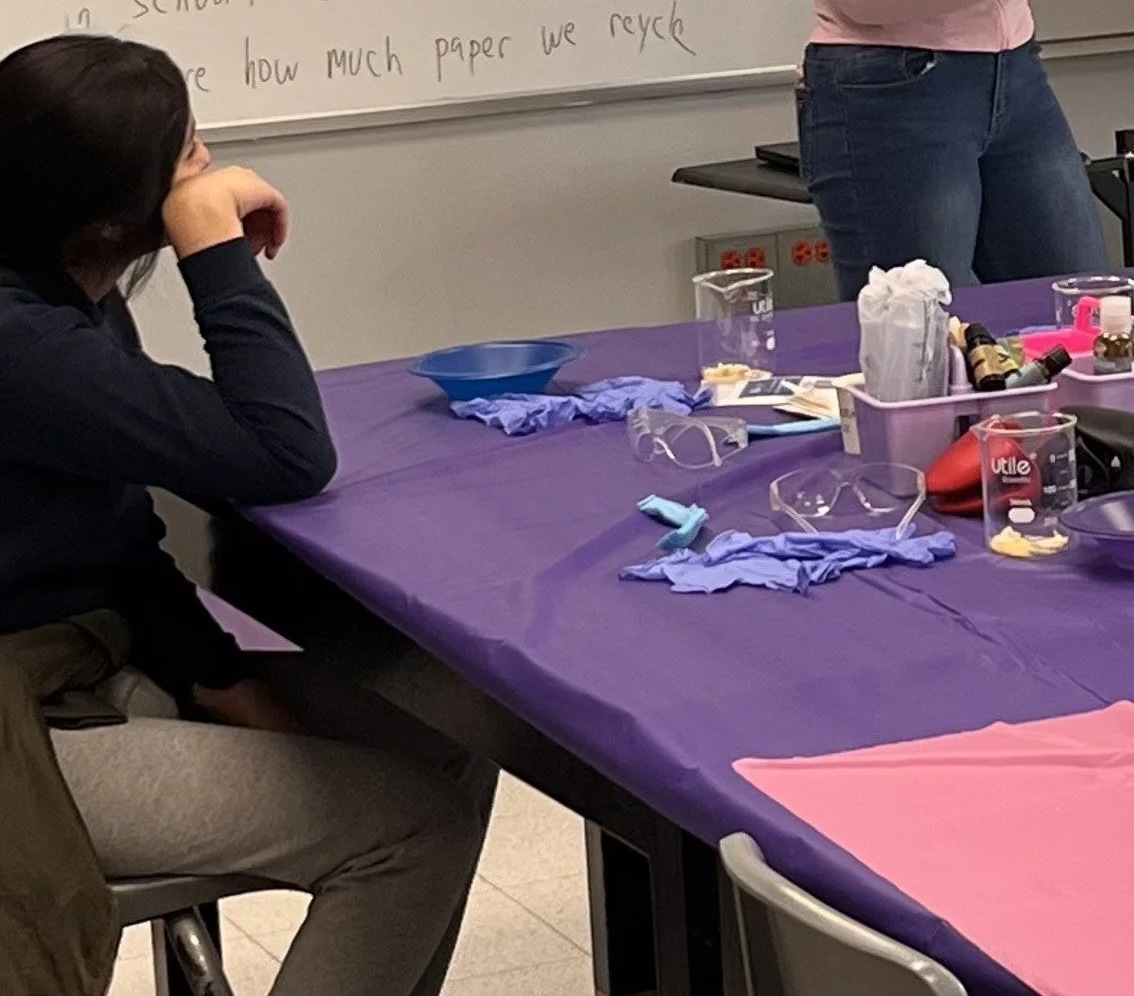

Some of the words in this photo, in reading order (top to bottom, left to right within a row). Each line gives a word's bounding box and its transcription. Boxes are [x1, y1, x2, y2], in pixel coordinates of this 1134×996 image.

[245, 35, 300, 90] how
[327, 35, 403, 79] much
[435, 36, 511, 83] paper
[542, 20, 577, 56] we
